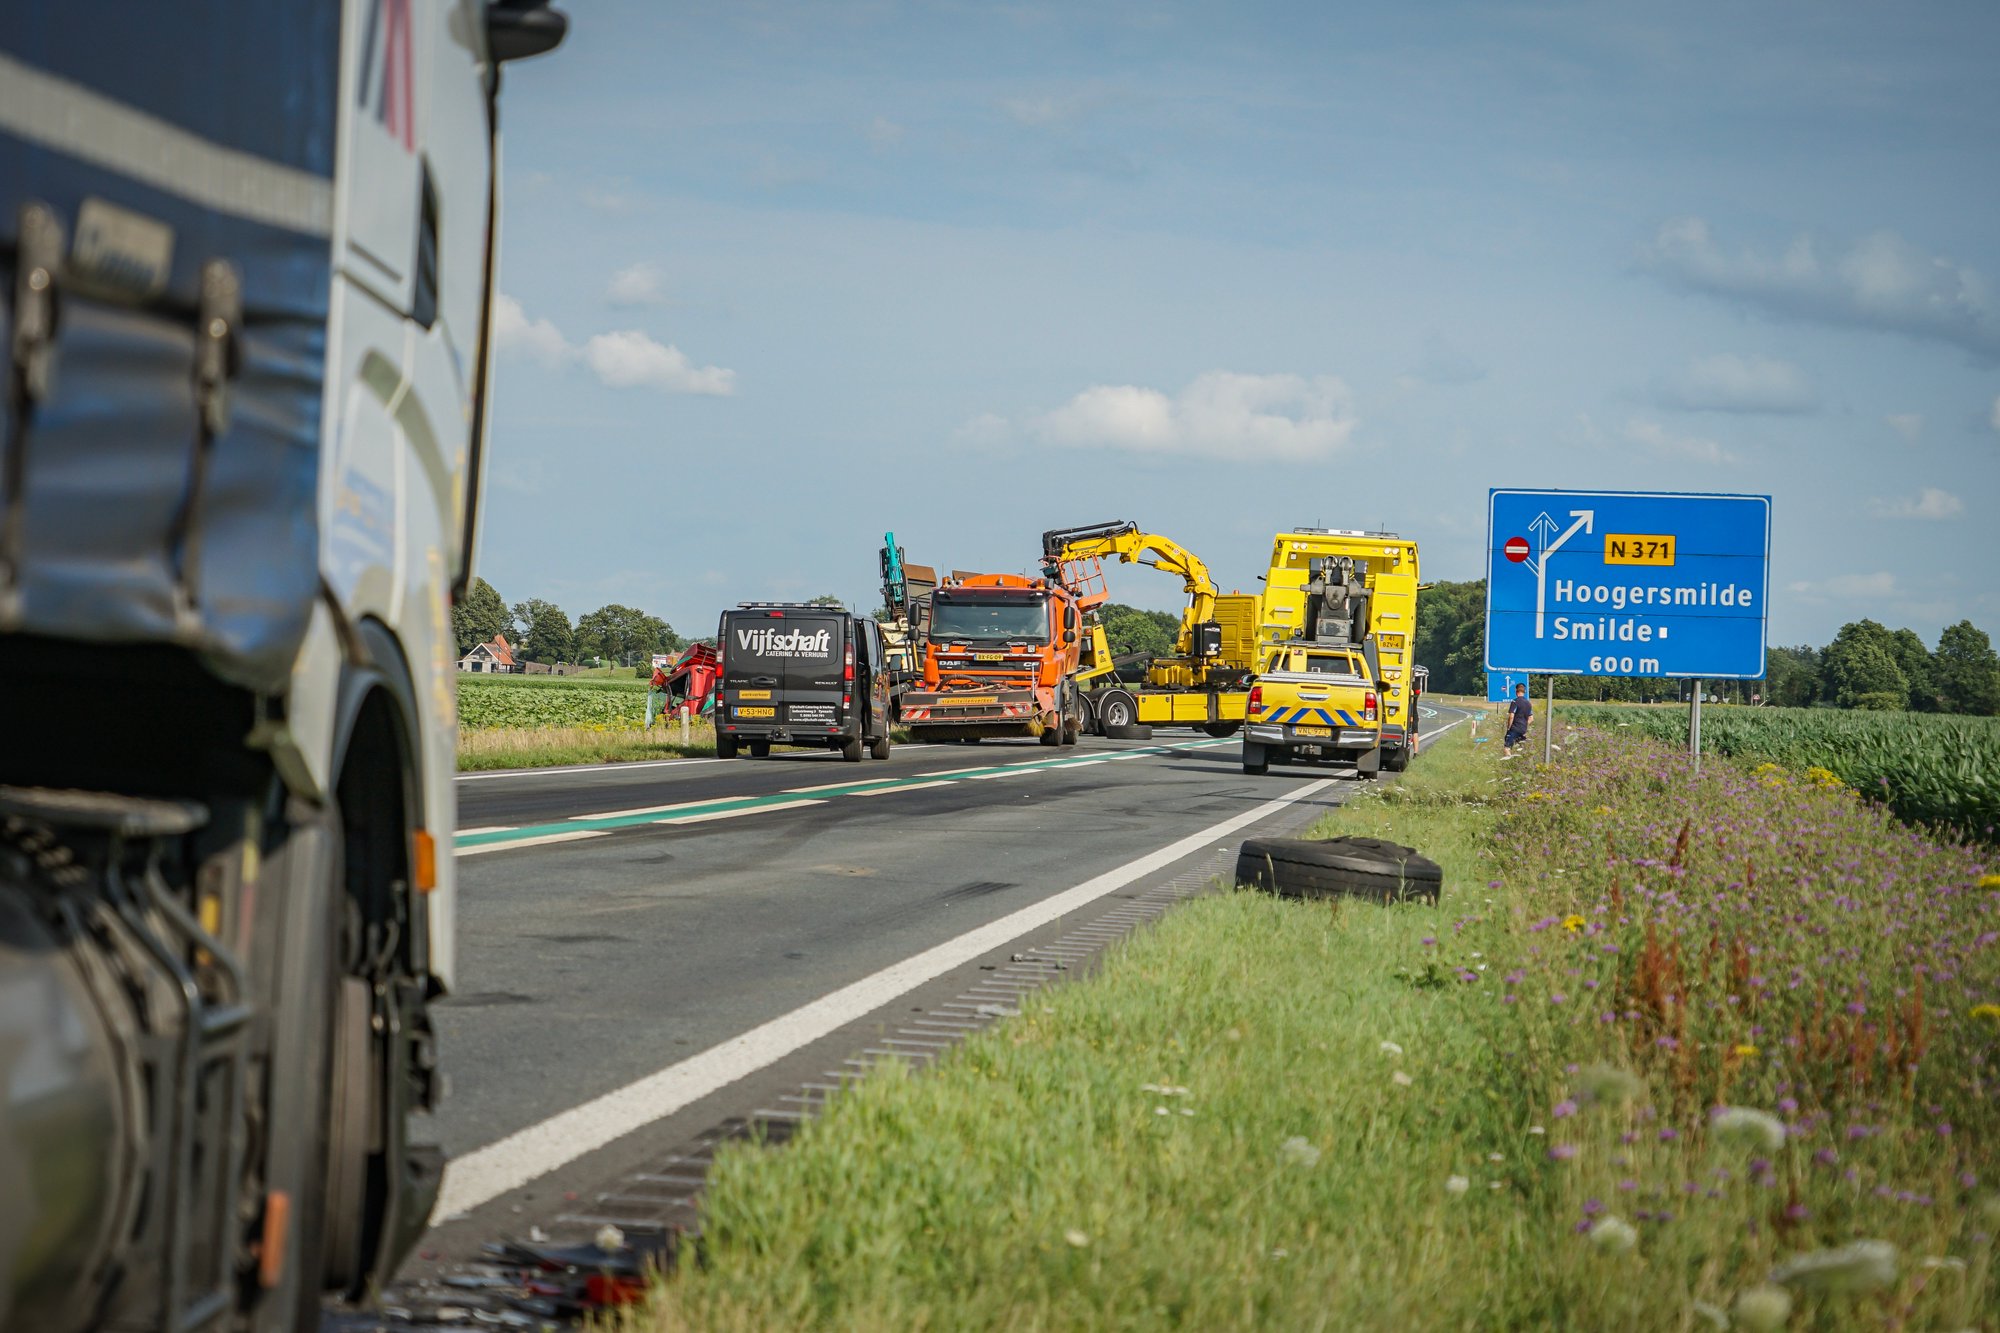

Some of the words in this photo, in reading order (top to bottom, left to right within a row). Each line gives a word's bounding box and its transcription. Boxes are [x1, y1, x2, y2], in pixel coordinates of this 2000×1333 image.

[1611, 541, 1626, 558] N
[1631, 541, 1670, 559] 371
[1554, 579, 1754, 610] Hoogersmilde
[1552, 616, 1653, 642] Smilde
[737, 628, 831, 657] Vijfschaft
[1589, 656, 1635, 673] 600
[1639, 657, 1660, 674] m
